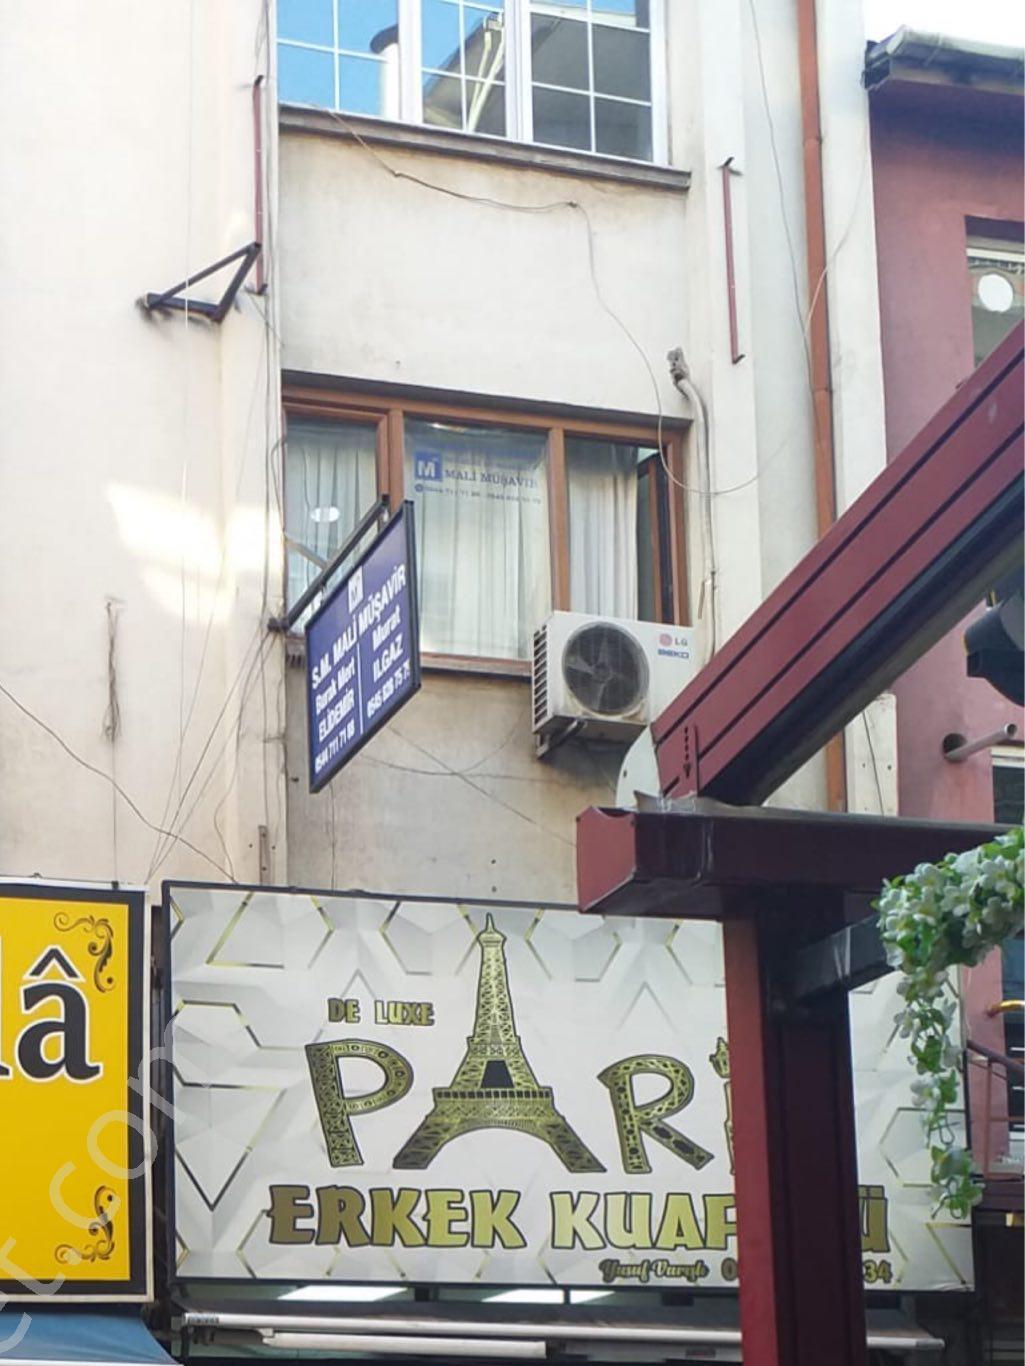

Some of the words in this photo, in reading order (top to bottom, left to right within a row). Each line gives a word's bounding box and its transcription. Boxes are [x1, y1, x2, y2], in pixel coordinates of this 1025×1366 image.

[333, 614, 357, 666] MALİ
[359, 564, 406, 637] MÜŞAVİR
[372, 605, 400, 652] Murat
[327, 997, 361, 1023] DE
[374, 1000, 435, 1026] LUXE
[266, 1184, 527, 1249] ERKEK
